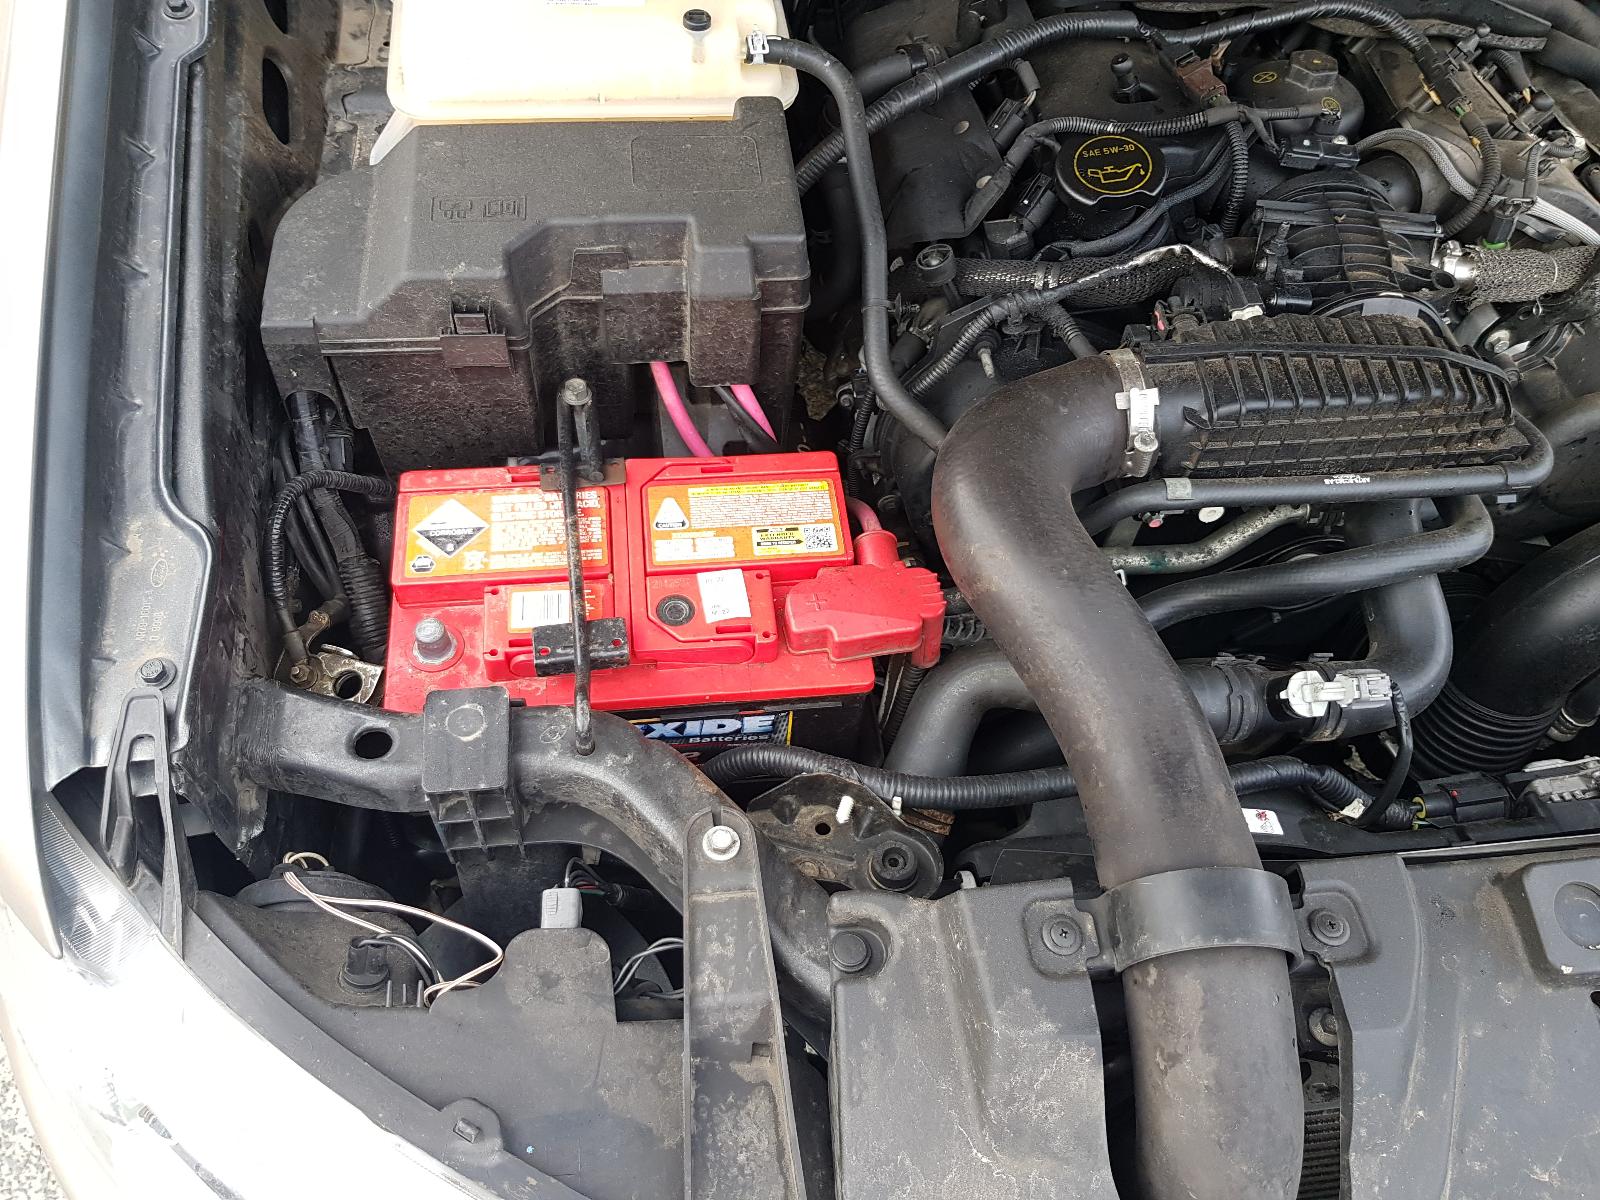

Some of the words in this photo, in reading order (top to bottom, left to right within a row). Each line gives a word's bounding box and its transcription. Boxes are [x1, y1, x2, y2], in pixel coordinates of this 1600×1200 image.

[1082, 149, 1101, 158] SAE
[1103, 144, 1135, 155] 5W-30
[430, 527, 474, 537] CORROSIVE
[634, 714, 776, 738] XIDE
[688, 734, 771, 744] Batteries
